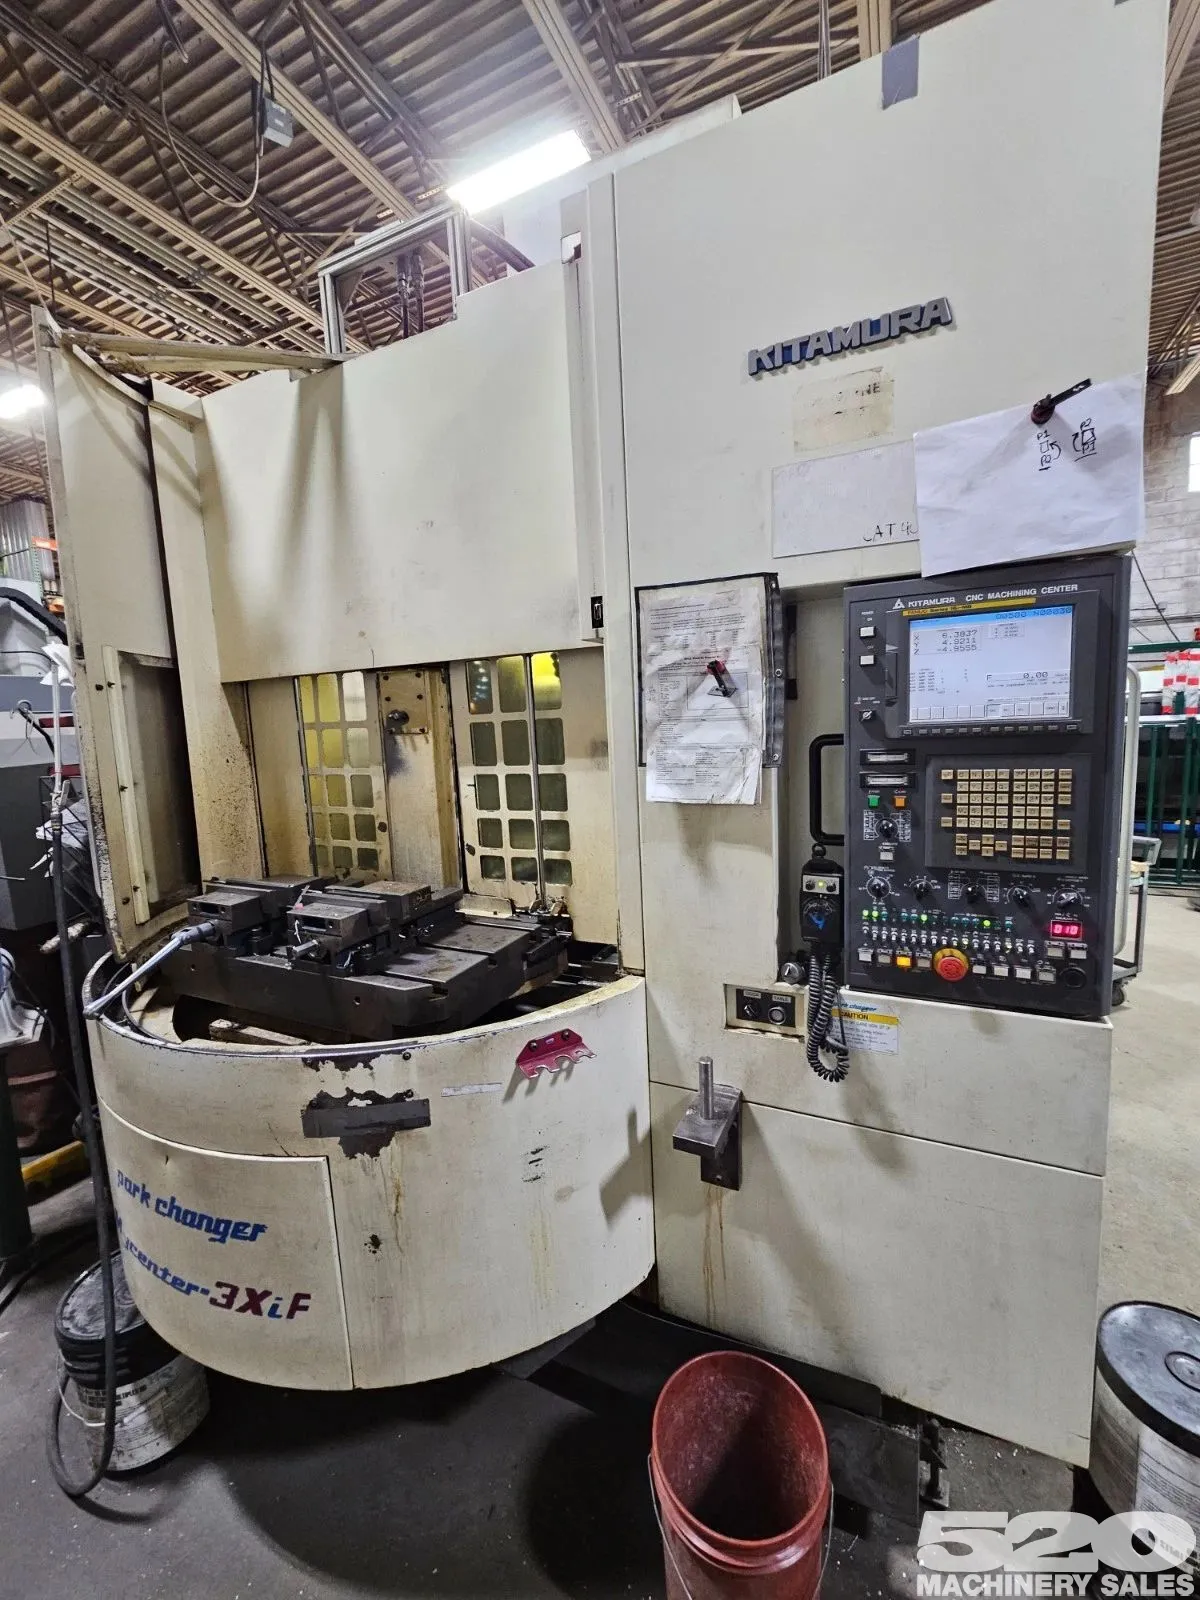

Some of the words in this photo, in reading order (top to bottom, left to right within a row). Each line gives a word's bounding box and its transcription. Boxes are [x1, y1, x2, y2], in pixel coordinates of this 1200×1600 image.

[748, 297, 953, 375] KITAMURA
[1036, 430, 1050, 440] P1
[908, 597, 956, 608] KITAMURA
[965, 593, 984, 602] CNC
[987, 587, 1037, 601] MACHINING
[1041, 584, 1078, 594] CENTER
[154, 1196, 268, 1244] changer
